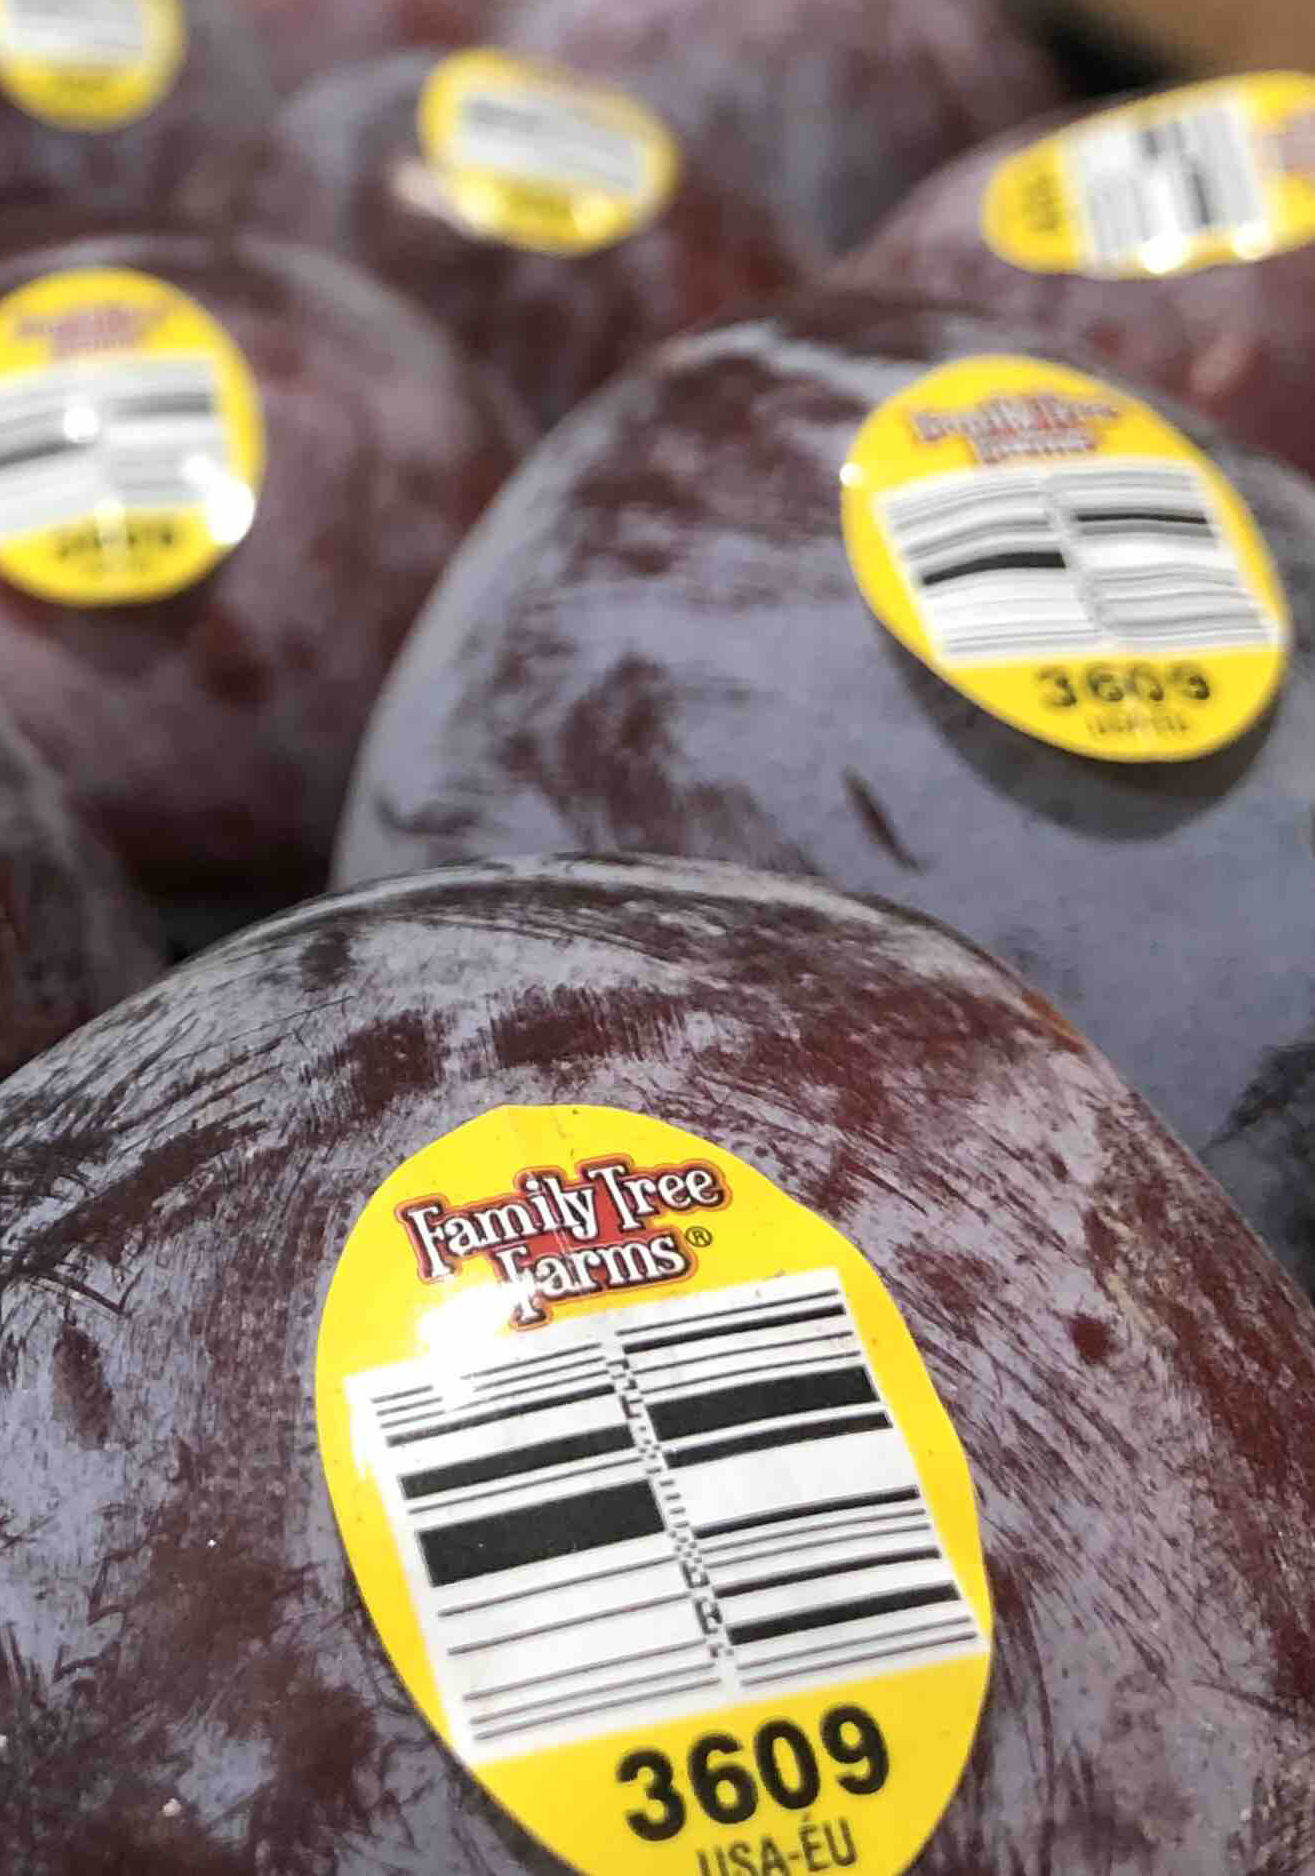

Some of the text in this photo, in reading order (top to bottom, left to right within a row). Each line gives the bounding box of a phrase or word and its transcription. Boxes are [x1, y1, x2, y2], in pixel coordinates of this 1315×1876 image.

[405, 1164, 723, 1278] Family Tree
[615, 1704, 889, 1841] 3609
